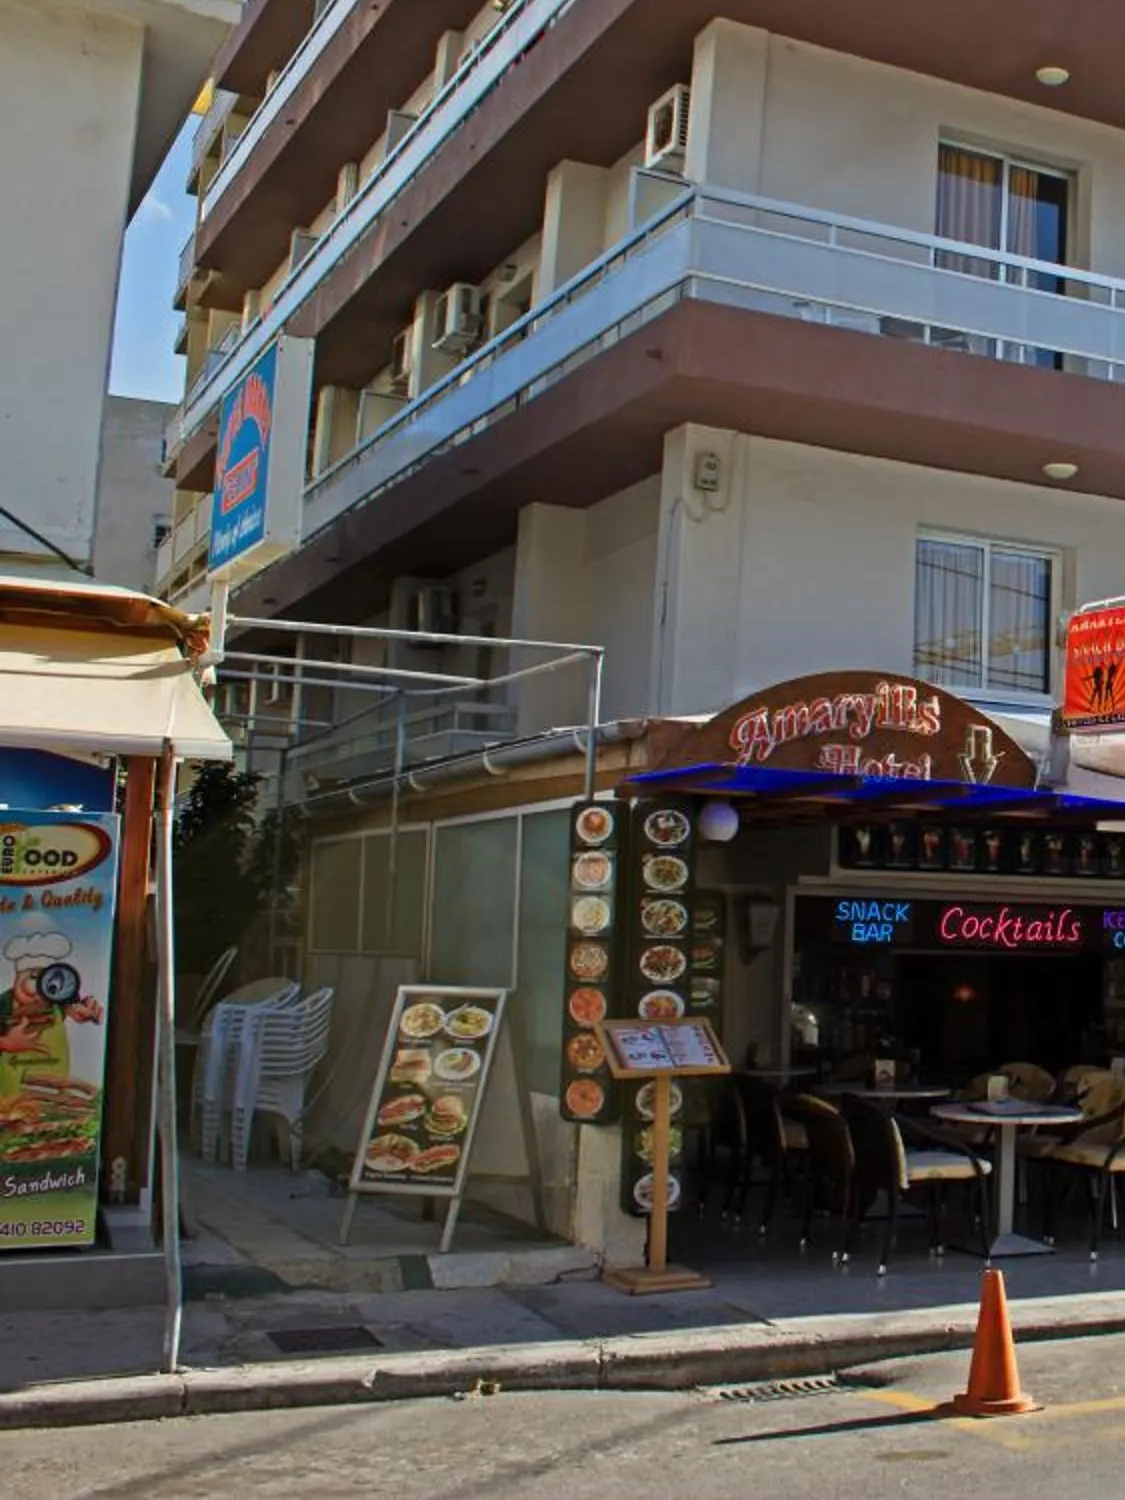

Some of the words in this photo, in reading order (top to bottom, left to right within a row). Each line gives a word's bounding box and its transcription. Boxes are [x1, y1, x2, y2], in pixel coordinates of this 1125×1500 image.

[729, 679, 941, 766] Amaryllis
[835, 901, 911, 922] SNACK
[1103, 911, 1125, 929] ICE
[851, 923, 893, 942] BAR
[940, 907, 1081, 947] Cocktails
[3, 1167, 86, 1197] Sandwich
